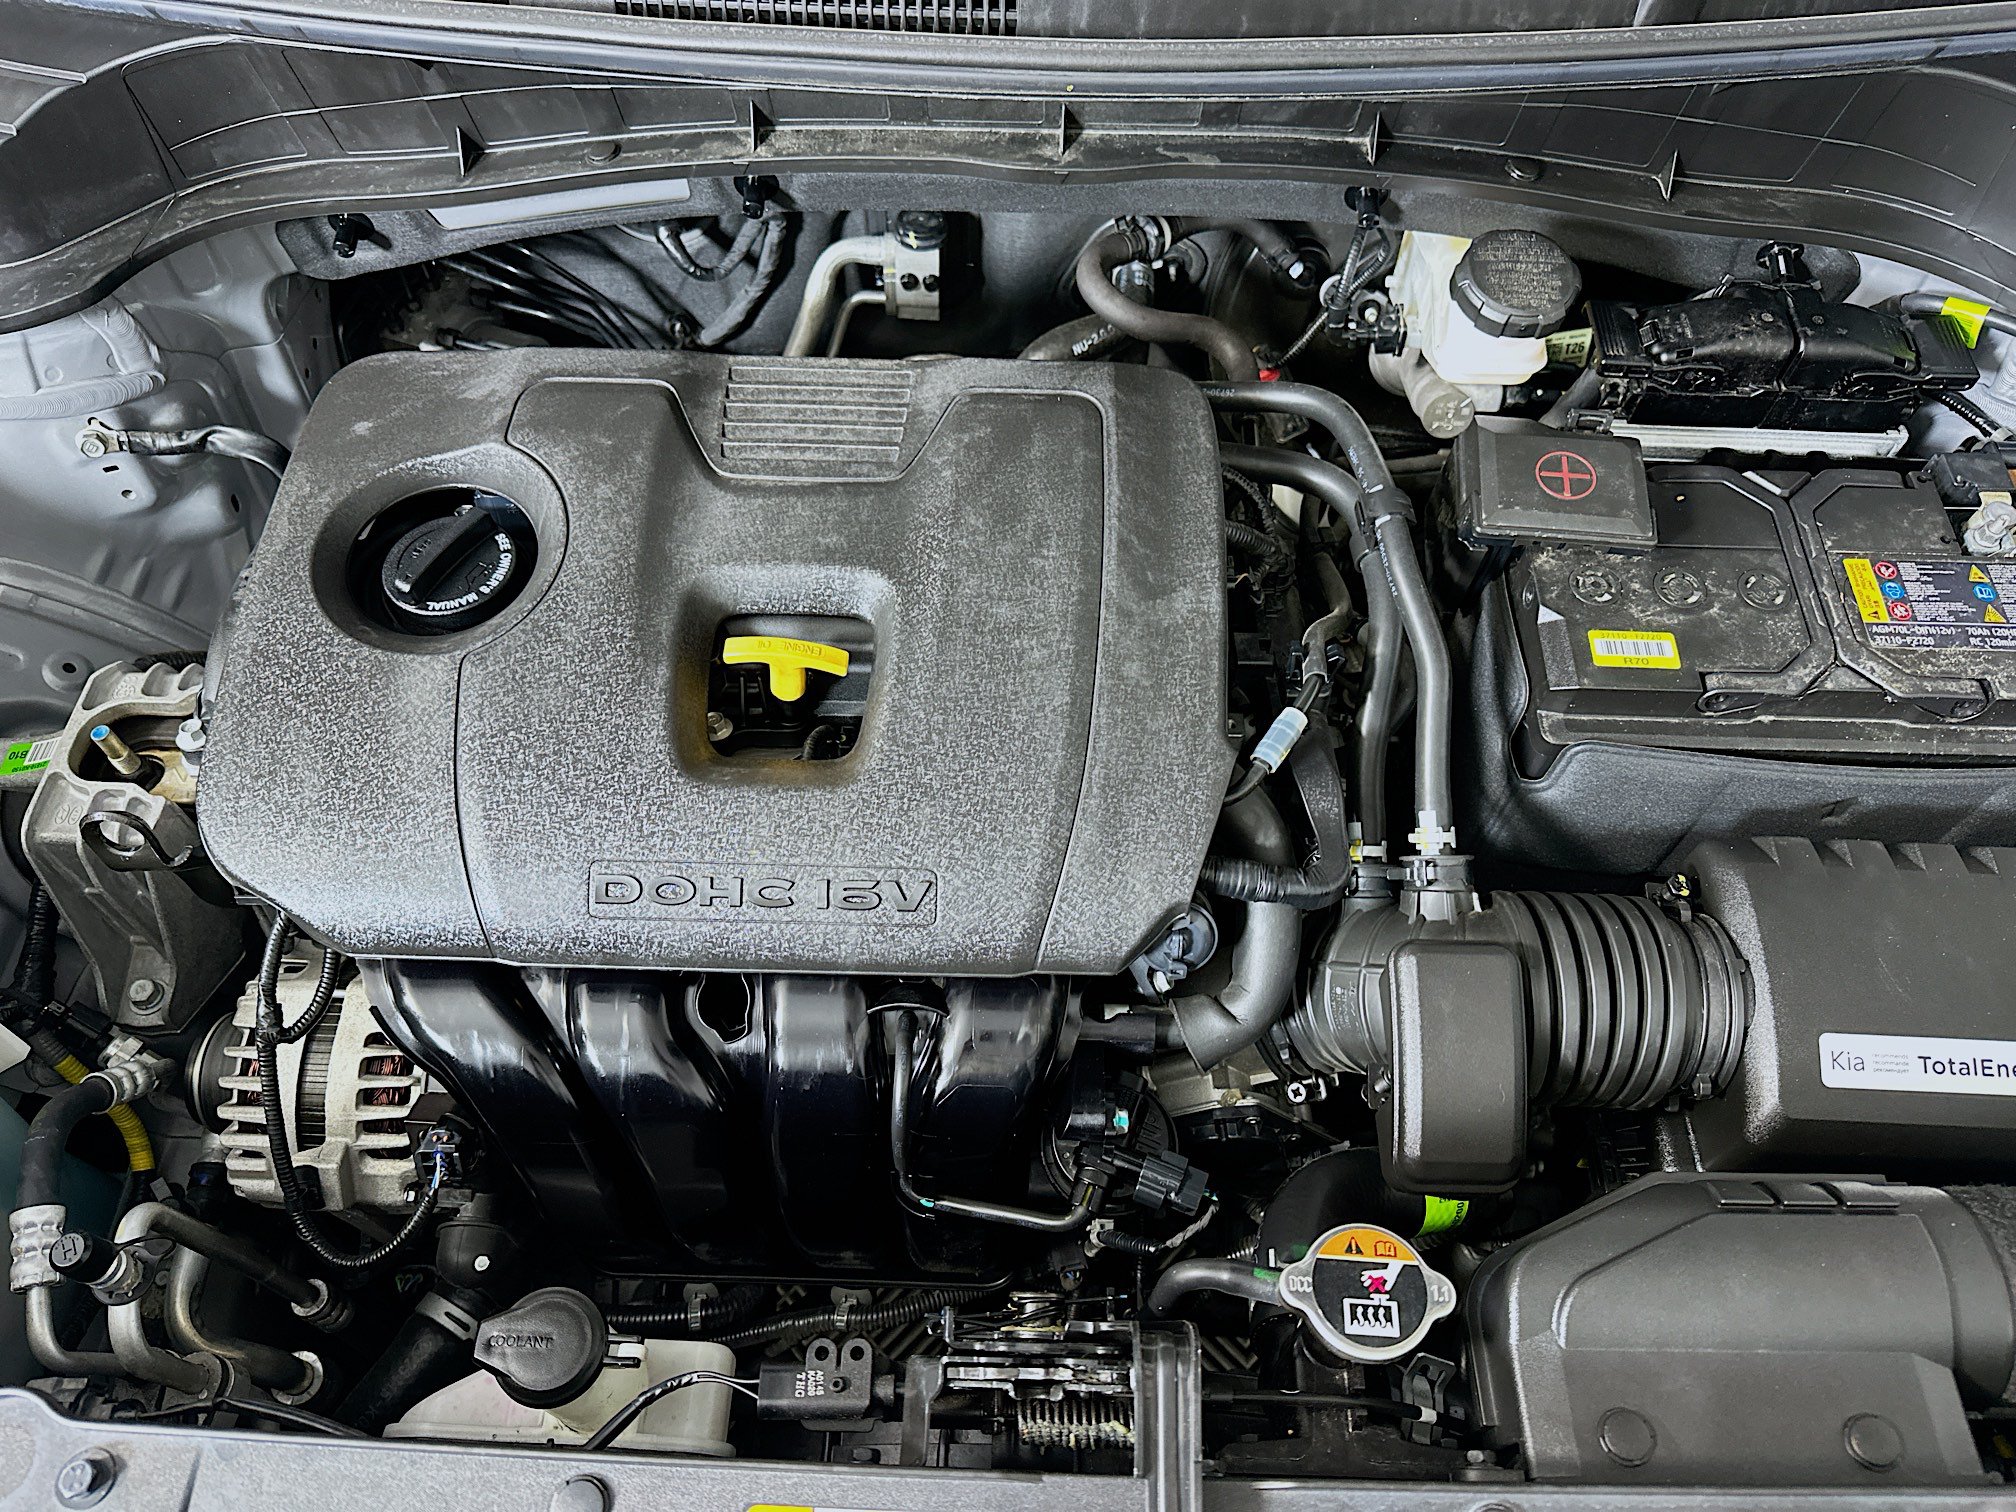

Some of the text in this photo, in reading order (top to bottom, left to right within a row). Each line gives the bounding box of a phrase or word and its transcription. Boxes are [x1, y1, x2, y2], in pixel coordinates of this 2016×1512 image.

[1565, 341, 1585, 355] T26
[427, 532, 512, 610] SEE OWNER'S MANUAL
[1967, 626, 1991, 636] 70Ah
[1874, 637, 2016, 647] 37110-F2720 RC 120min
[1623, 657, 1649, 665] R70
[9, 750, 28, 761] B10
[594, 873, 934, 913] DOHC 16V
[1831, 1050, 1866, 1071] Kia
[1288, 1275, 1449, 1302] DCC 1.1
[488, 1333, 553, 1348] COOLANT
